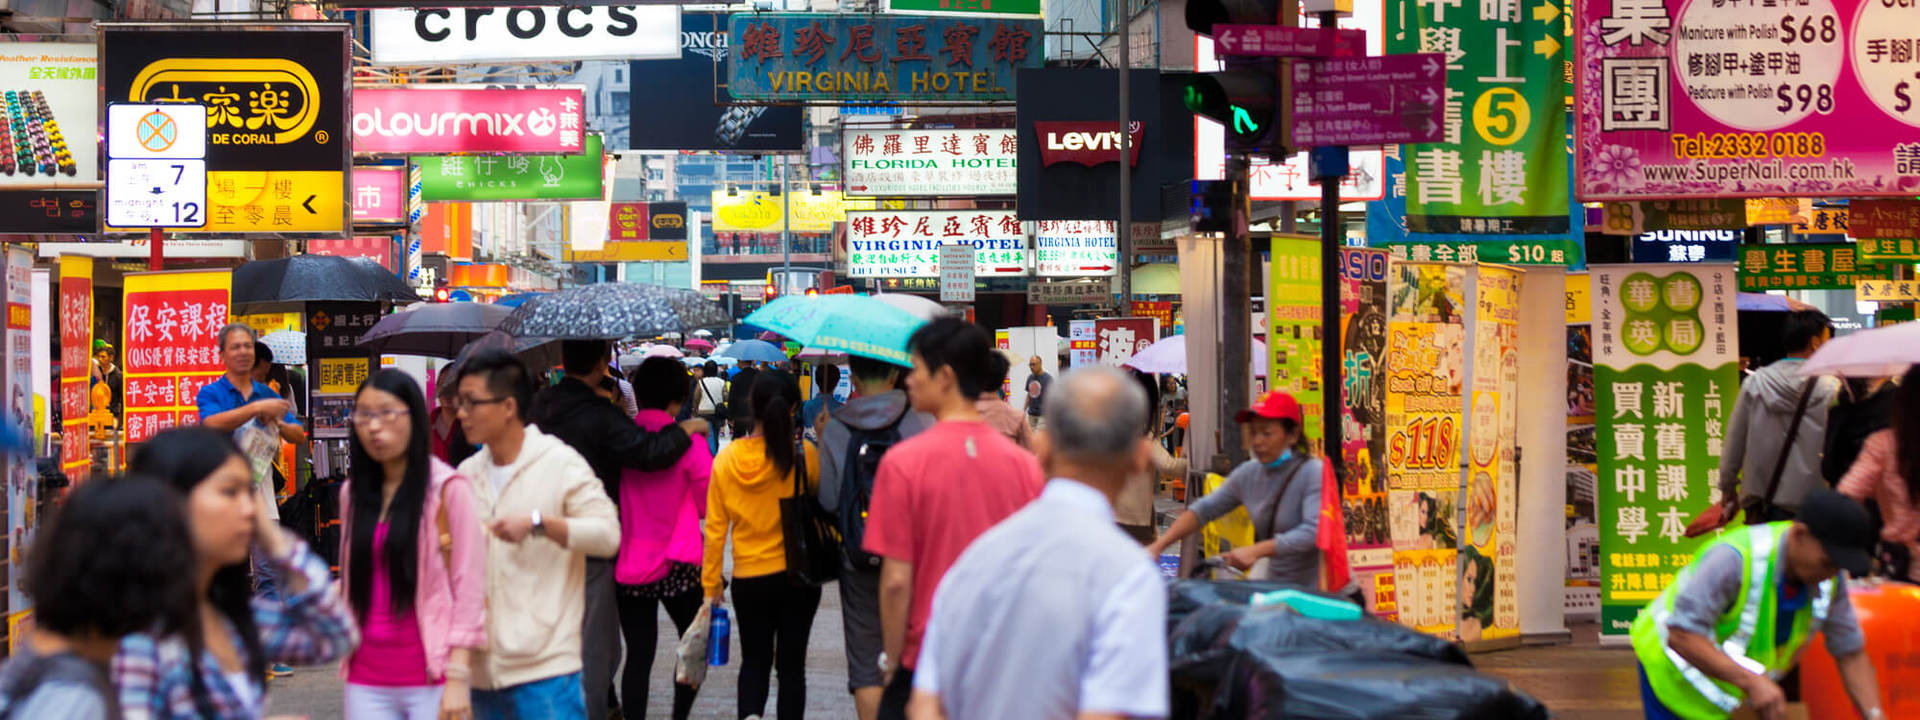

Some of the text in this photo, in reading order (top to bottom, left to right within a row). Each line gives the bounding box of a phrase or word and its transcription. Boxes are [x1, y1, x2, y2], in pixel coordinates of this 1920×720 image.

[415, 6, 638, 42] crocs
[1679, 14, 1836, 45] Manicure with Polish $68
[741, 22, 1032, 67] 維珍尼亞賓館
[1867, 38, 1920, 63] 手腳
[40, 54, 97, 63] Resistance
[768, 71, 1006, 92] VIRGINIA HOTEL
[1688, 83, 1834, 114] Pedicure with Polish $98
[213, 133, 274, 145] DE CORAL
[852, 133, 1017, 157] 佛羅里達賓館
[1774, 133, 1825, 156] 0188
[171, 165, 185, 185] 7
[851, 158, 1018, 170] FLORIDA HOTEL
[1643, 158, 1856, 184] www.SuperNail.com.hk
[357, 185, 381, 208] 市
[172, 202, 199, 223] 12
[852, 215, 1024, 238] 維珍尼亞賓館
[1640, 229, 1734, 242] SUNING
[852, 240, 943, 250] VIRGINIA
[1038, 237, 1116, 248] VIRGINIA HOTEL
[1508, 244, 1544, 262] $10
[1862, 239, 1920, 254] 學生書
[1744, 248, 1855, 273] 學生書屋
[127, 301, 227, 342] 保安課程
[1343, 349, 1372, 407] 折
[1611, 381, 1649, 545] 買賣中學
[1651, 380, 1691, 545] 新舊課本
